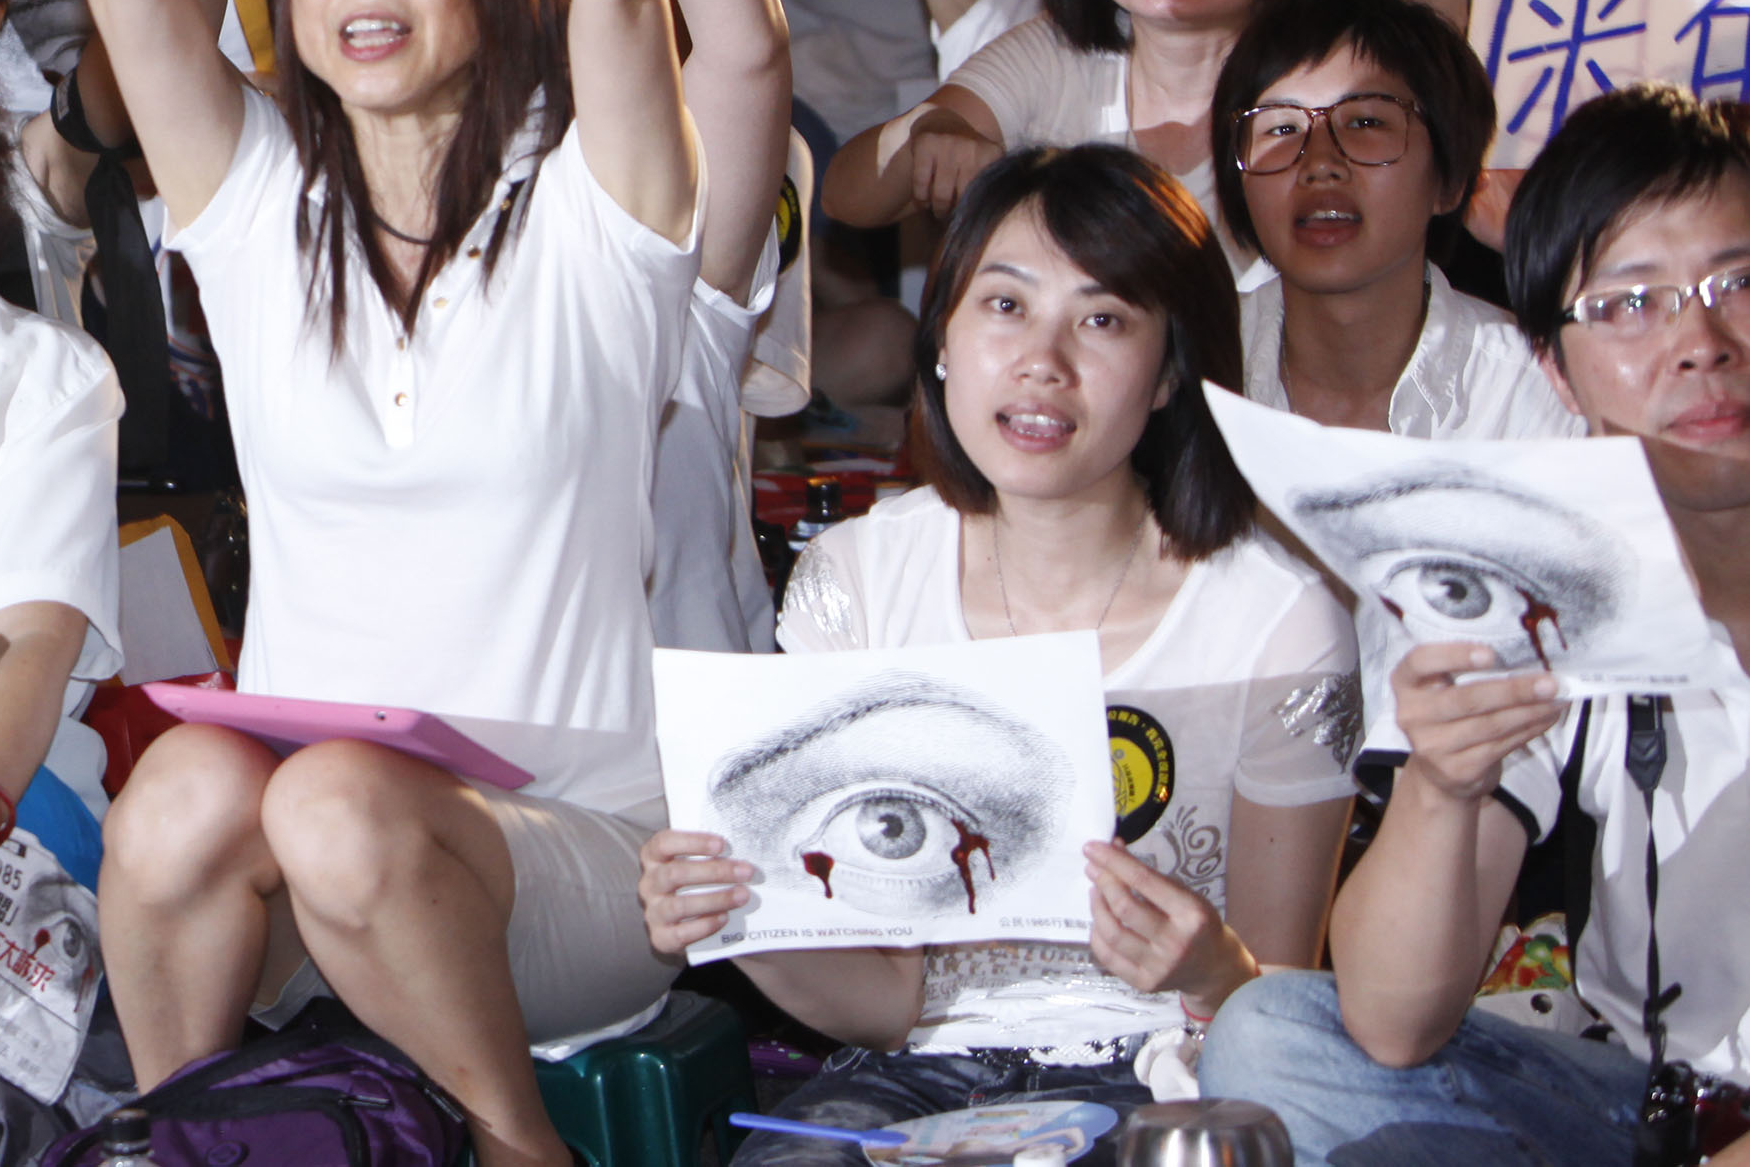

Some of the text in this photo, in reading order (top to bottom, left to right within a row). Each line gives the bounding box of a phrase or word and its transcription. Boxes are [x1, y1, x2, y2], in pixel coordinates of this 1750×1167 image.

[722, 926, 913, 944] BIG CITIZEN IS WATCHING YOU
